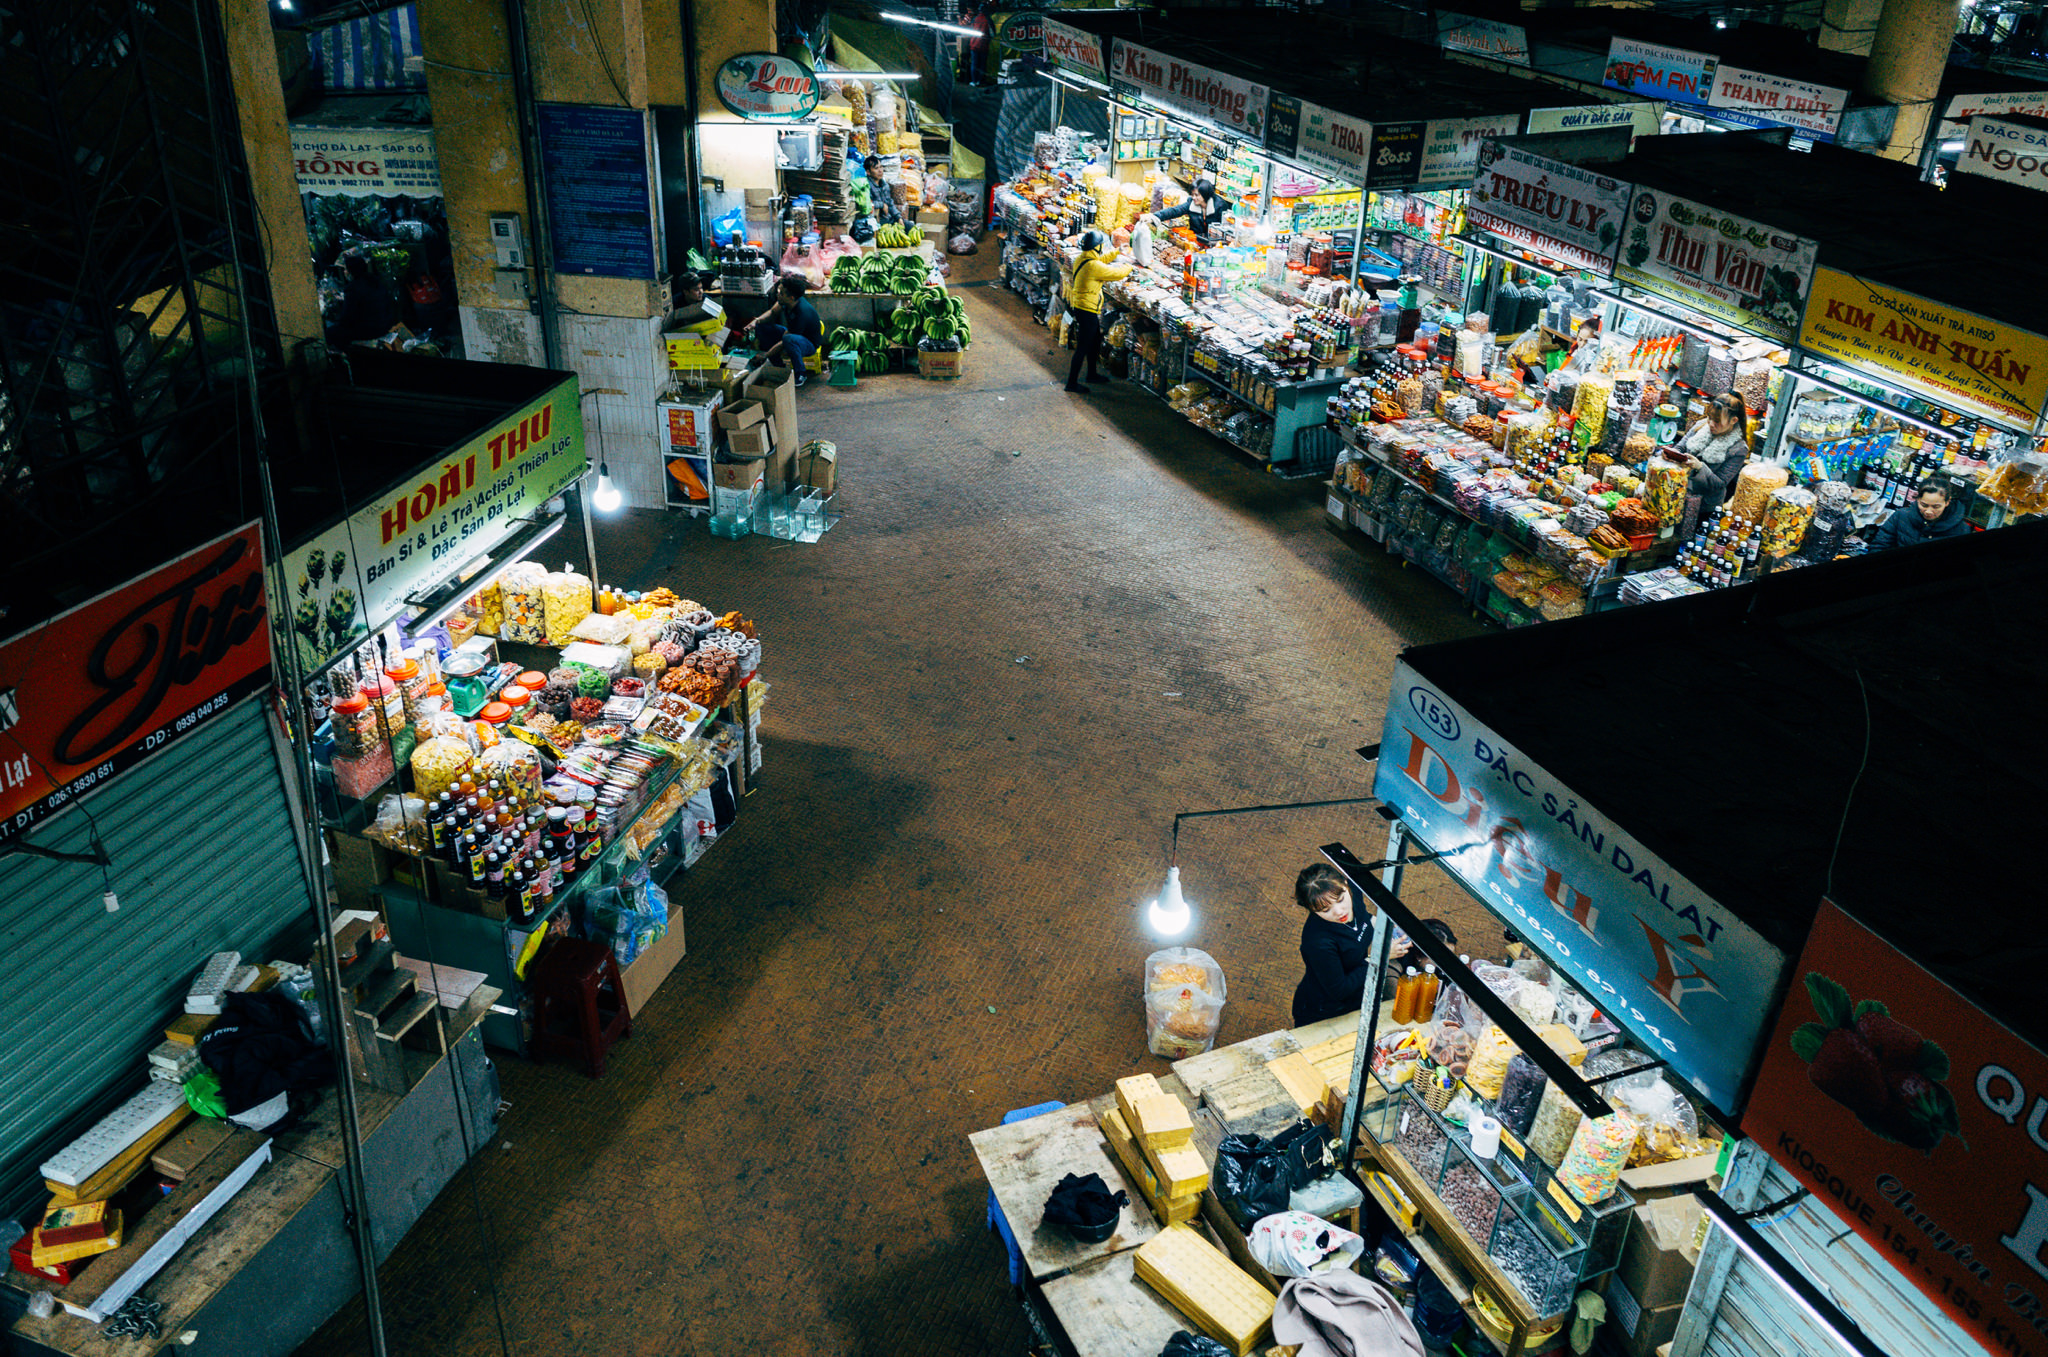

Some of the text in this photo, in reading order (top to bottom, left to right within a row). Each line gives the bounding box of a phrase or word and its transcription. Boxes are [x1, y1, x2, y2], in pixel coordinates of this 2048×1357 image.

[747, 60, 816, 96] Lan
[1124, 47, 1247, 125] Kim Phượng
[1622, 60, 1698, 95] TÂM AN
[1721, 81, 1780, 107] THANH
[1331, 123, 1364, 156] THOA
[1561, 110, 1589, 126] QUẦY
[1612, 108, 1633, 122] SẢN
[1983, 124, 2021, 140] ĐẶC
[302, 142, 329, 153] CHỢ
[331, 142, 348, 152] ĐÀ
[382, 144, 405, 154] SẠP
[408, 143, 425, 154] SỐ
[1376, 145, 1412, 167] Boss
[1491, 172, 1568, 220] TRIỀU
[1567, 199, 1606, 233] LY
[1656, 223, 1707, 275] Thu
[1714, 240, 1768, 297] Vân
[1817, 341, 1840, 354] Kiosque
[1825, 299, 2032, 386] KIM ANH TUẤN
[1899, 302, 1918, 319] SẢN
[1919, 307, 1946, 326] XUẤT
[1948, 319, 1965, 333] TRÀ
[1967, 325, 1995, 342] ATISÔ
[1814, 322, 1848, 343] Chuyên
[1850, 334, 1872, 352] Bán
[1944, 369, 1971, 388] Loại
[1972, 378, 1992, 395] Trà
[380, 403, 553, 545] HOÀI THU
[367, 556, 395, 586] Bán
[417, 532, 429, 552] &
[431, 515, 449, 541] Lẻ
[452, 500, 475, 525] Trà
[475, 472, 515, 509] Actisô
[518, 452, 550, 480] Thiên
[551, 434, 572, 459] Lộc
[432, 485, 526, 562] Đặc Sản Đà Lạt
[4, 752, 33, 789] Lạt
[16, 806, 36, 830] ĐT
[73, 773, 98, 796] 3830
[97, 758, 116, 780] 651
[176, 713, 198, 734] 0938
[197, 704, 215, 723] 040
[214, 692, 231, 713] 255
[1418, 694, 1724, 944] 153 ĐẶC SẢN DALAT
[1777, 1131, 1982, 1320] KIOSQUE 154 155
[1875, 1172, 1993, 1288] Chuyên
